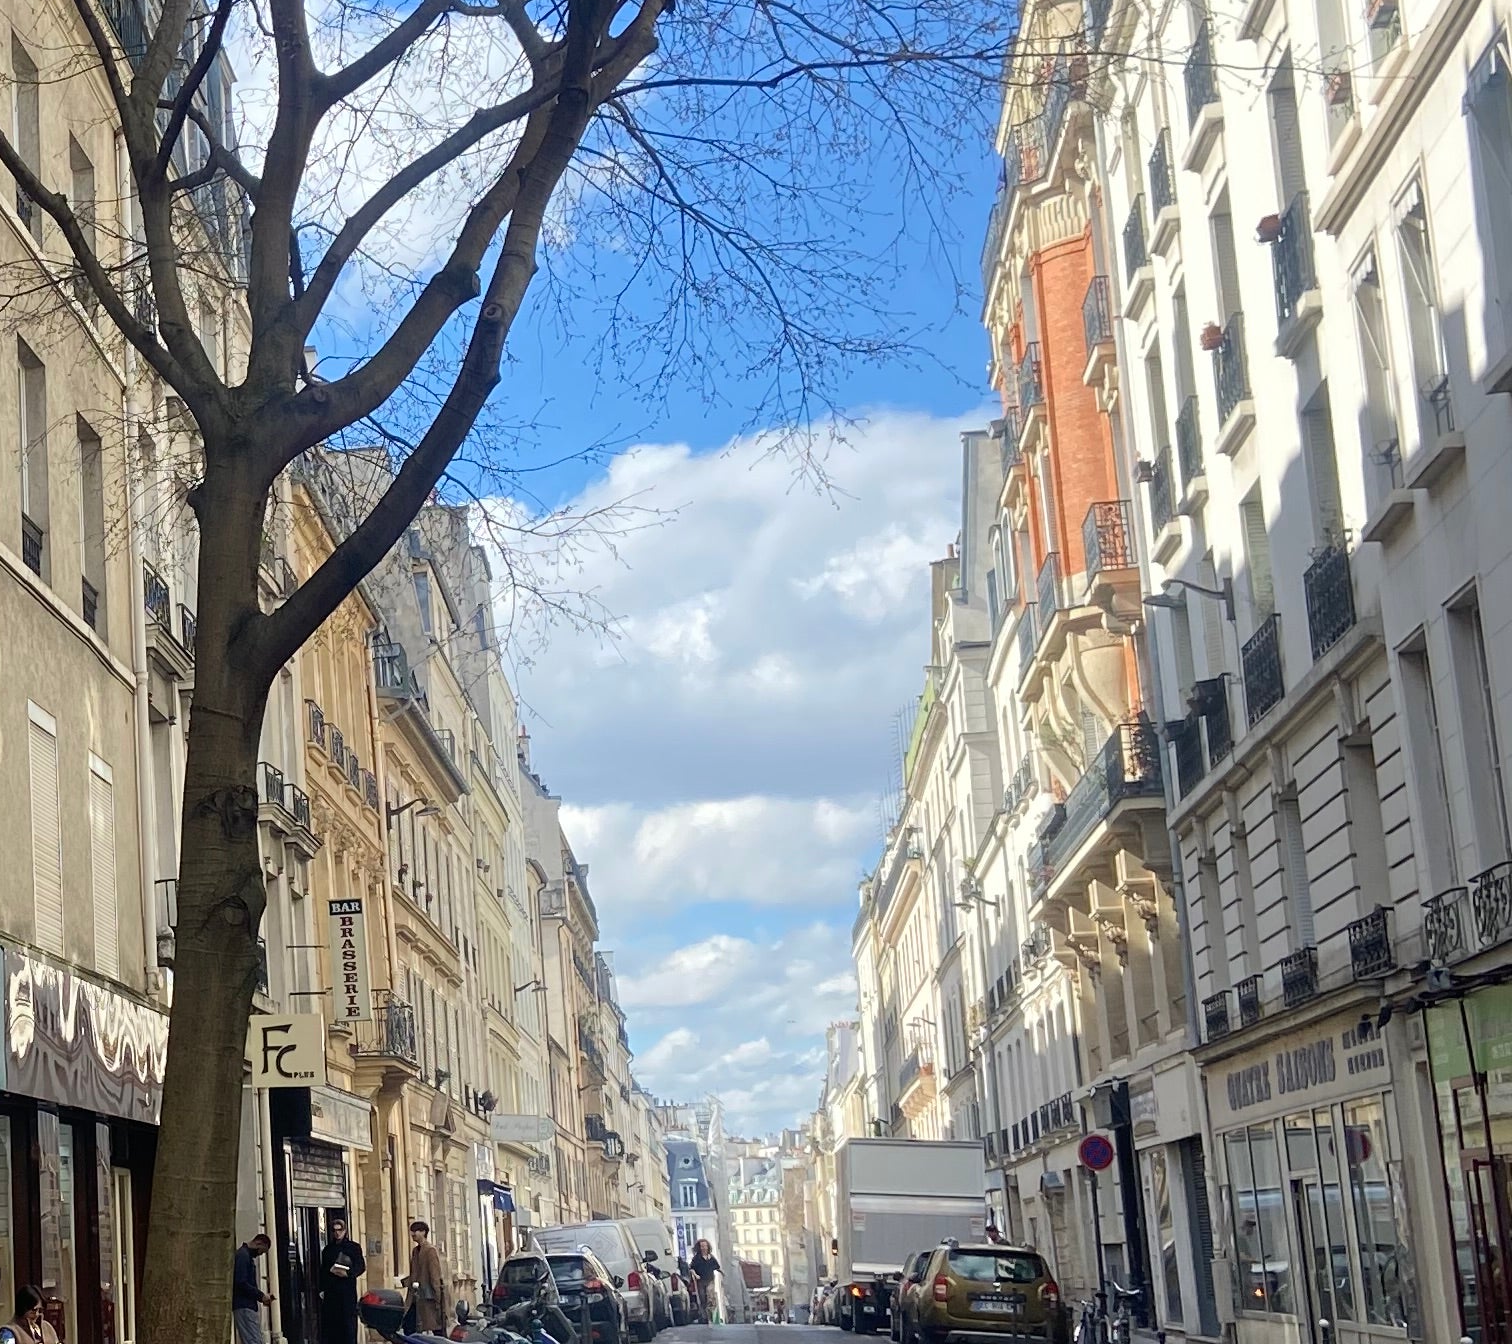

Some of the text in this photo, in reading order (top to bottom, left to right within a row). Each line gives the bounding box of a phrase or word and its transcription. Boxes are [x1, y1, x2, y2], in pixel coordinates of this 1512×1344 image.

[331, 901, 361, 914] BAR
[339, 916, 361, 1018] BRASSERIE
[1227, 1060, 1272, 1112] QUATRE
